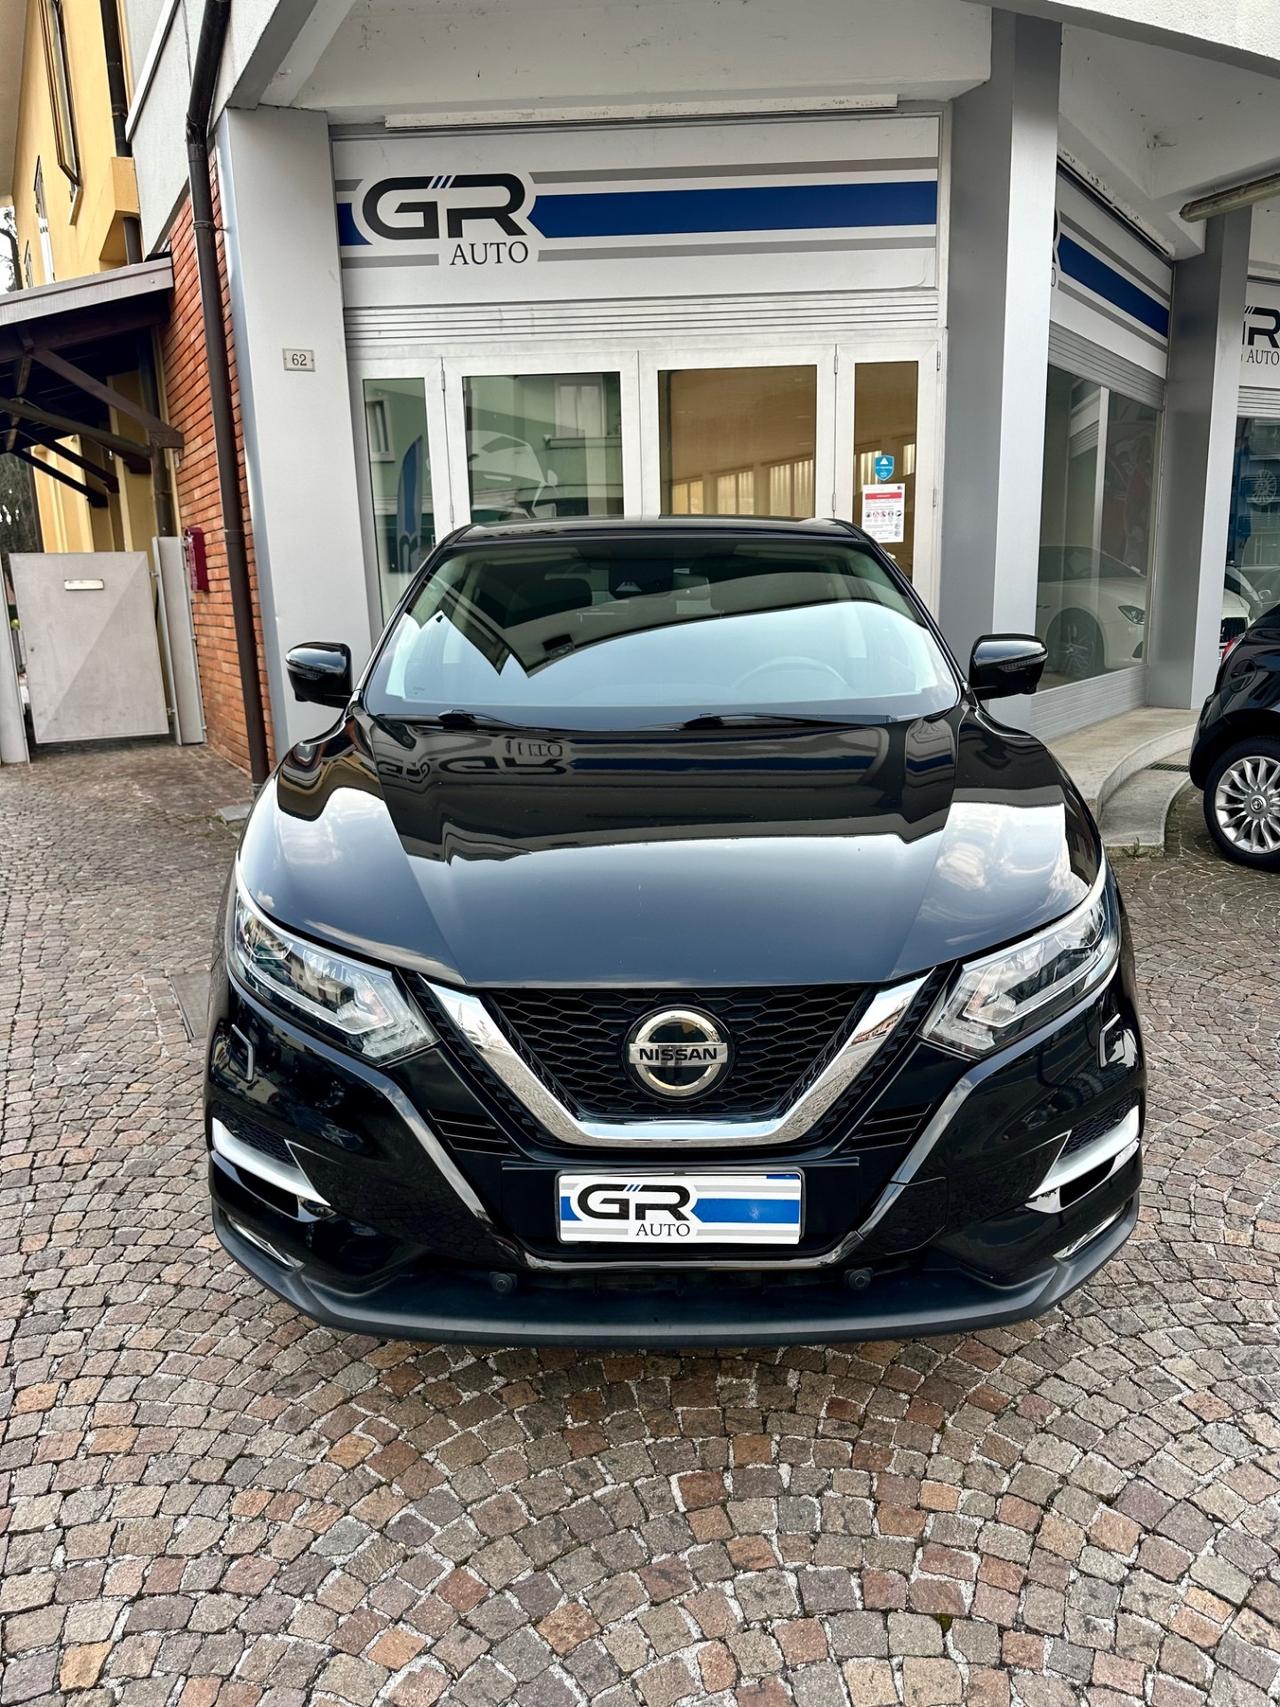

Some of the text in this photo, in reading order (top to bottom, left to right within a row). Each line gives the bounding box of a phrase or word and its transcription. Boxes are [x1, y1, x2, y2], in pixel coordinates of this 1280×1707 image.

[362, 172, 528, 241] GR
[449, 240, 529, 266] AUTO
[291, 353, 307, 366] 62
[1246, 348, 1280, 366] AUTO
[639, 1047, 717, 1061] NISSAN
[577, 1183, 691, 1221] GR
[635, 1223, 691, 1237] AUTO
